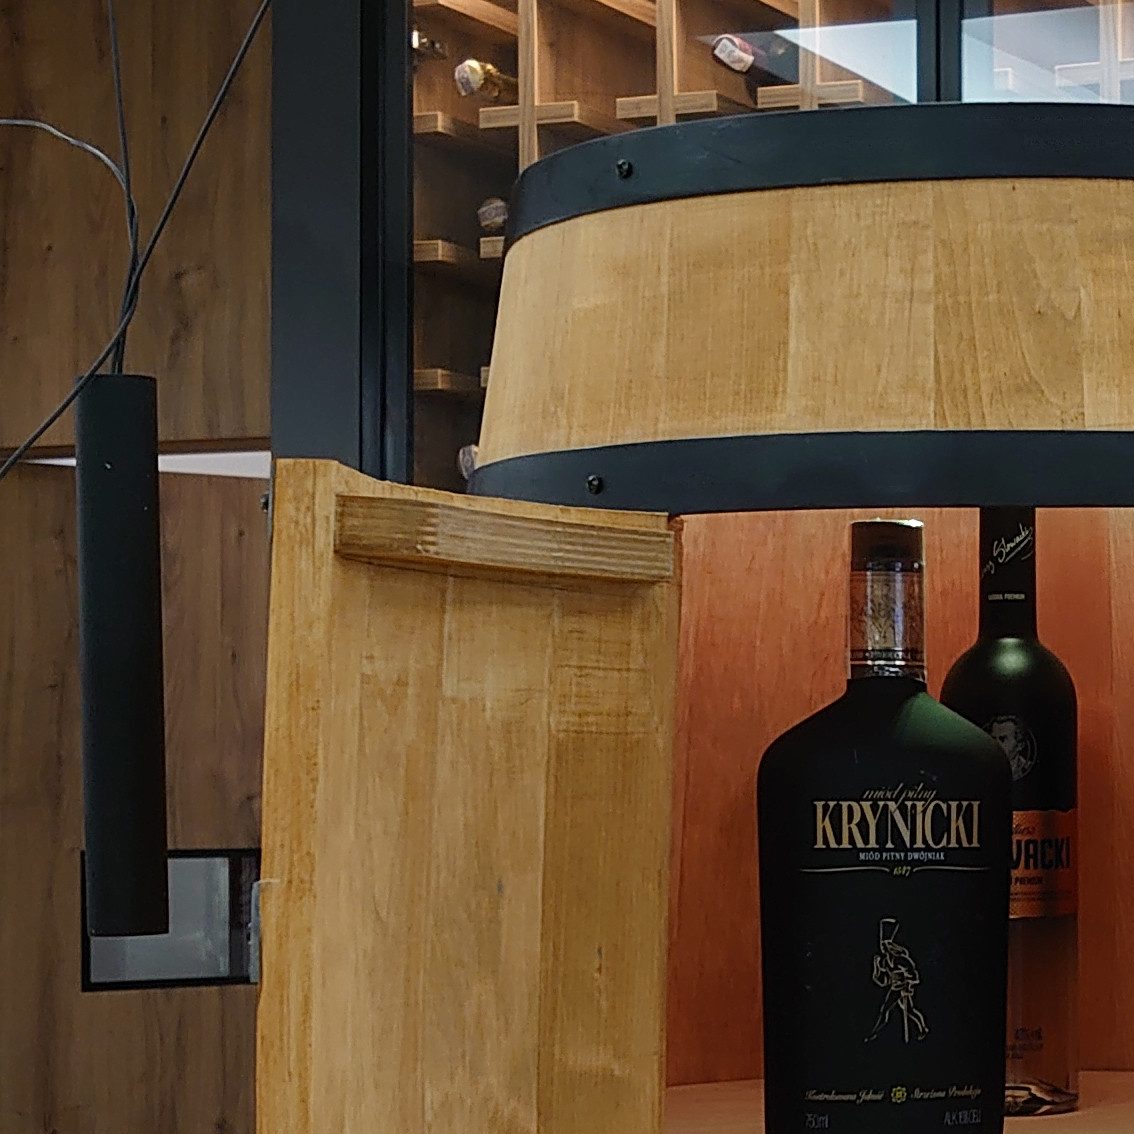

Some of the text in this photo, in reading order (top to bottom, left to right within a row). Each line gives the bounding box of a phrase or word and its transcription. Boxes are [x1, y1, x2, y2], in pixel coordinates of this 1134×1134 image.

[813, 800, 981, 849] KRYNICKI
[859, 850, 945, 862] MIÓD PITNY DWÓJNIAK
